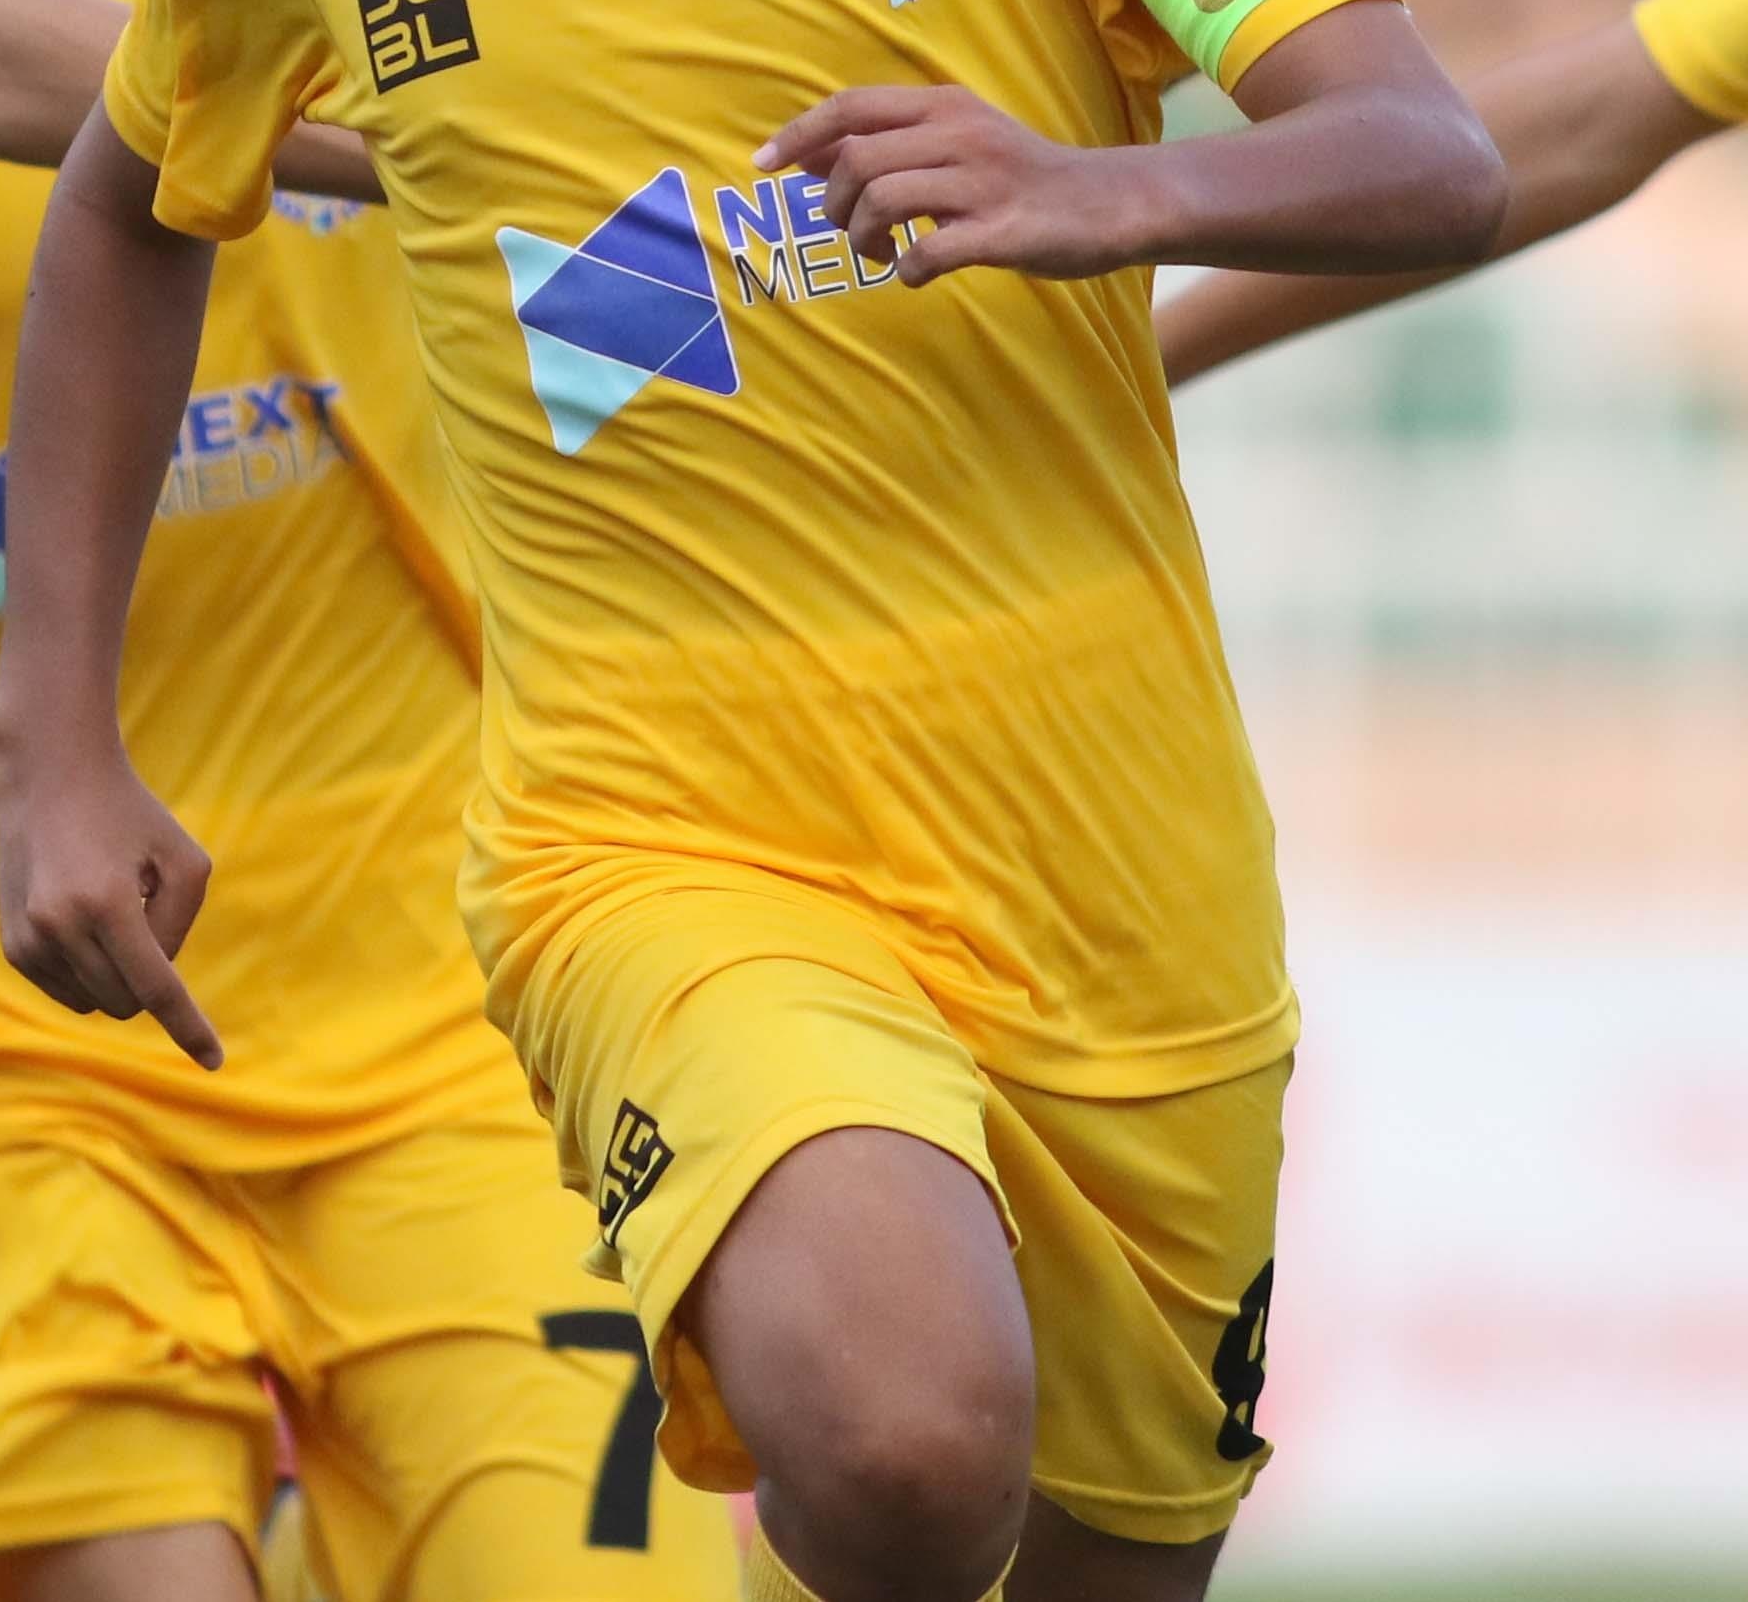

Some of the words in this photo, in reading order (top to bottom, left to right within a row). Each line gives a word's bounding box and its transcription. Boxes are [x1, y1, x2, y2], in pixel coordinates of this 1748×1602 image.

[713, 172, 844, 250] NE
[730, 220, 924, 306] MED
[173, 375, 340, 457] EXT
[537, 1310, 660, 1551] 7
